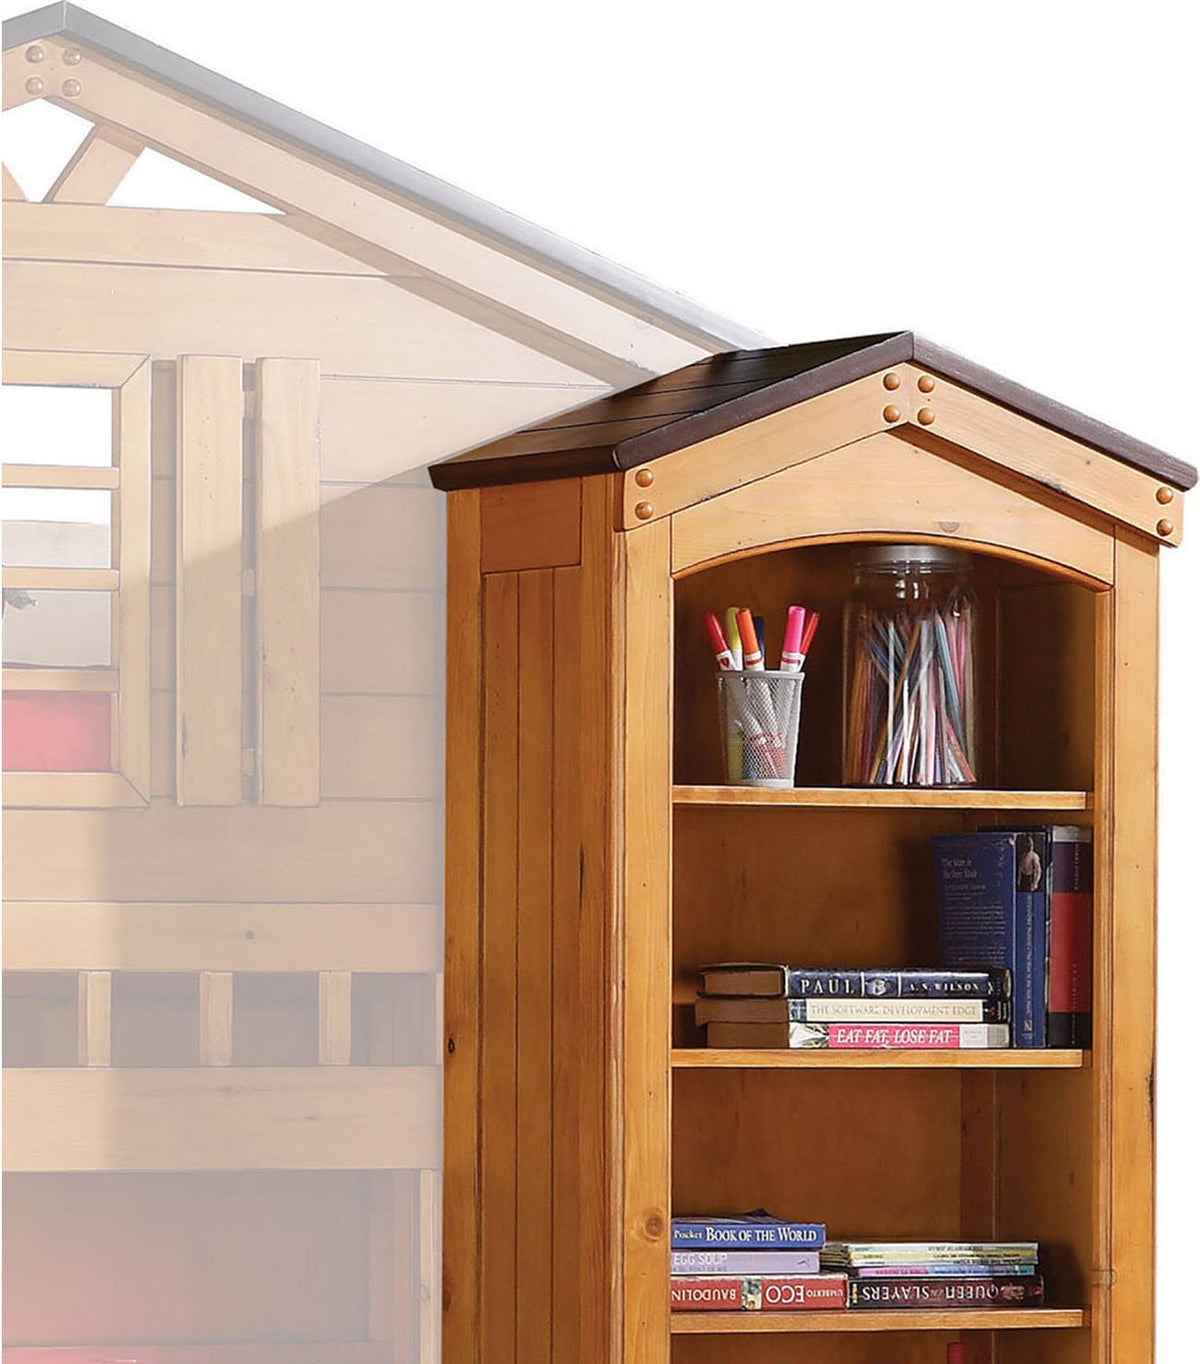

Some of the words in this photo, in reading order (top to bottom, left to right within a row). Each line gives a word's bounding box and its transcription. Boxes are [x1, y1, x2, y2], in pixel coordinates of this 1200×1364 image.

[801, 979, 855, 994] PAUL
[934, 983, 979, 991] WILSON
[810, 1005, 828, 1015] THE
[832, 1005, 880, 1015] SOFTWARE
[883, 1005, 949, 1015] DEVELOPMENT
[952, 1005, 977, 1015] EDGE
[837, 1029, 862, 1043] EAT
[894, 1029, 926, 1044] LOSE
[929, 1029, 953, 1044] FAT
[673, 1252, 695, 1265] EGG
[698, 1252, 727, 1265] SOUP
[765, 1285, 805, 1303] ECO
[806, 1289, 843, 1298] UMBERTO
[862, 1285, 930, 1300] SLAYERS
[945, 1284, 999, 1299] QUEEN
